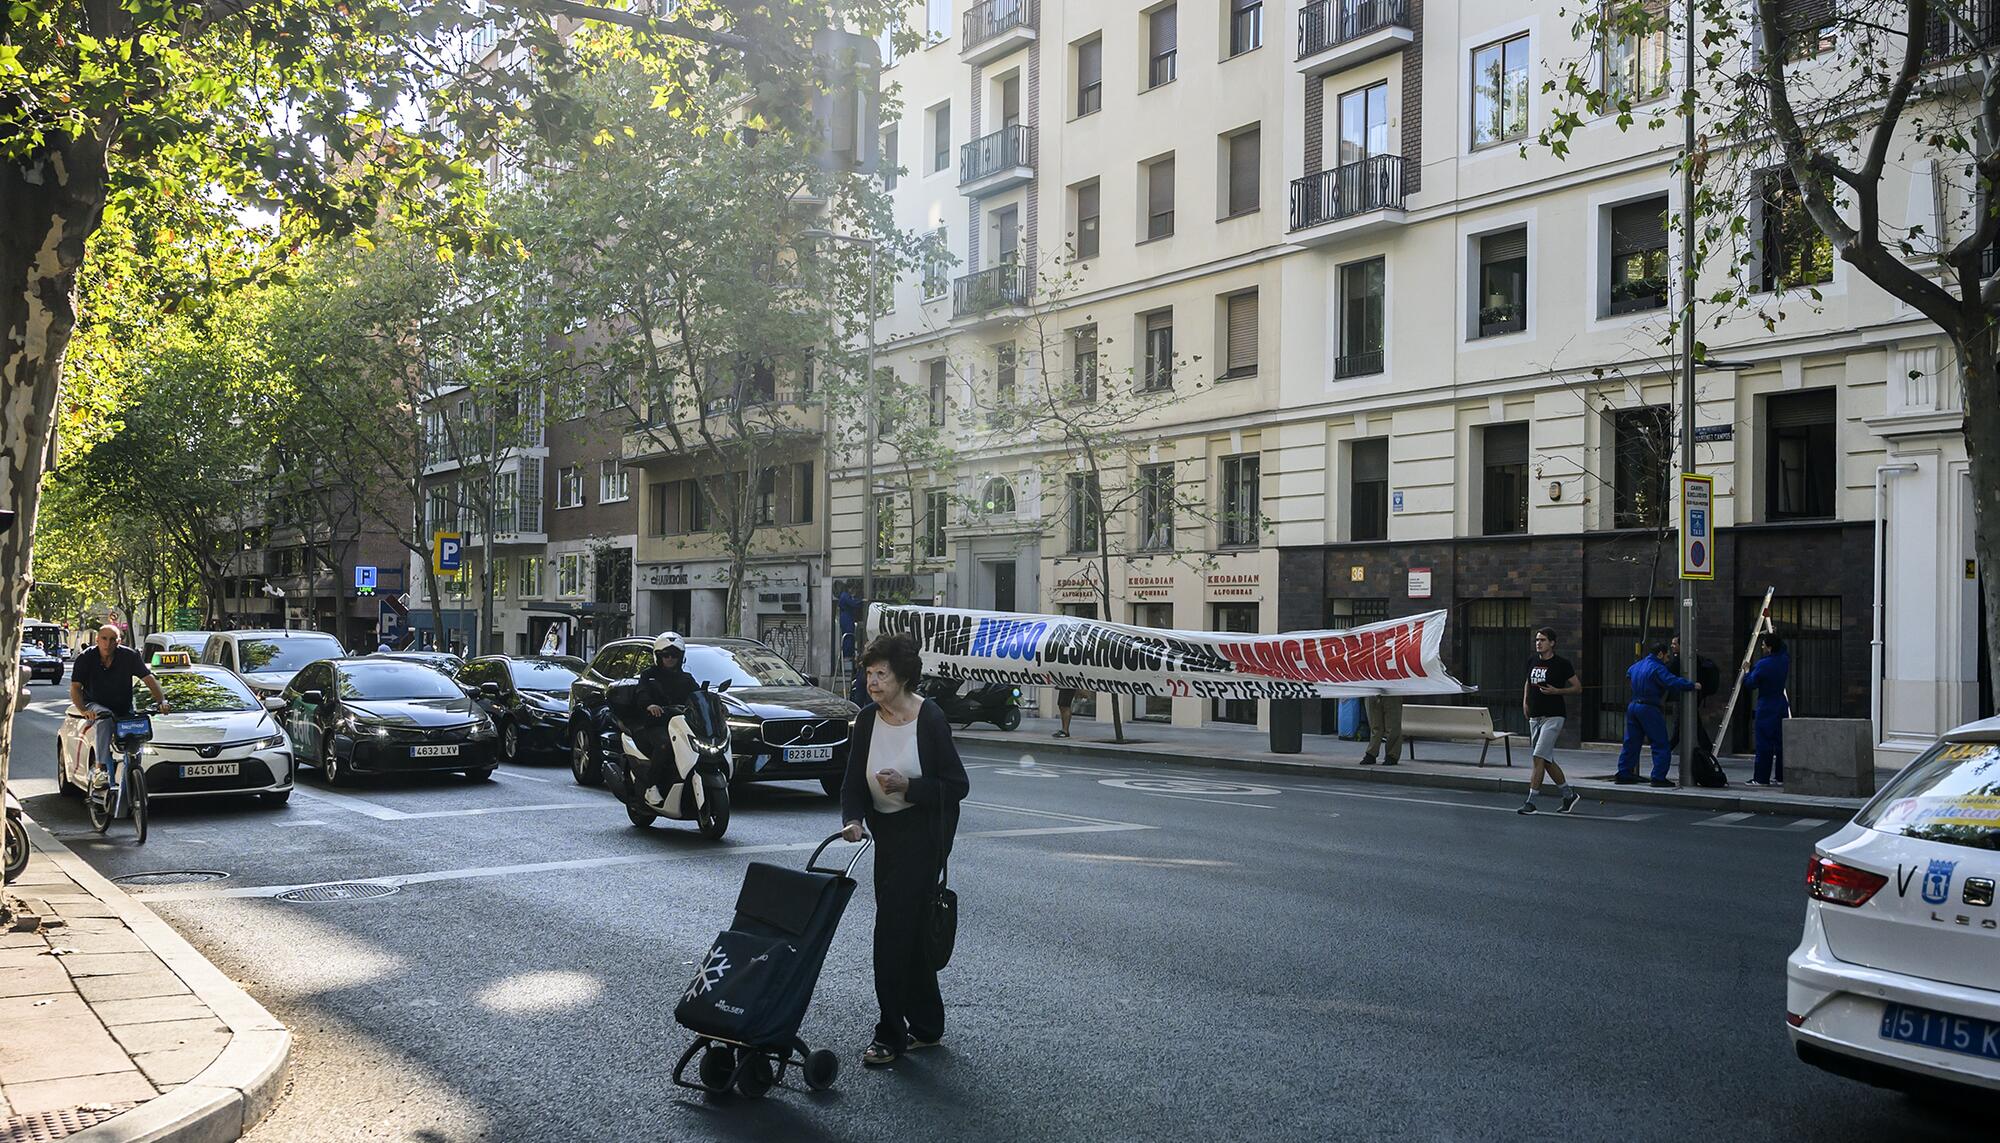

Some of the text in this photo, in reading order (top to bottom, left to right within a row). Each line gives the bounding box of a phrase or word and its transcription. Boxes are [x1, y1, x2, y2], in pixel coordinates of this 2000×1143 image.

[1207, 575, 1260, 583] KHODADIAN
[1352, 567, 1364, 580] 36
[1128, 577, 1174, 585] KHODADIAN
[924, 612, 972, 656] PARA
[971, 617, 1047, 666] AYUSO,
[1045, 623, 1167, 671] DESAHUCIO
[1166, 638, 1235, 672] PARA
[1219, 620, 1428, 683] MARICARMEN
[161, 655, 178, 664] TAXI
[1530, 668, 1548, 679] FCK
[1166, 678, 1193, 697] 22
[1192, 680, 1321, 700] SEPTIEMBRE
[417, 746, 458, 755] 4632 LXV
[788, 749, 830, 759] 8238 LZL
[187, 763, 237, 777] 8450 MXT
[1897, 863, 1918, 898] V
[1900, 1009, 2000, 1056] 5115 K
